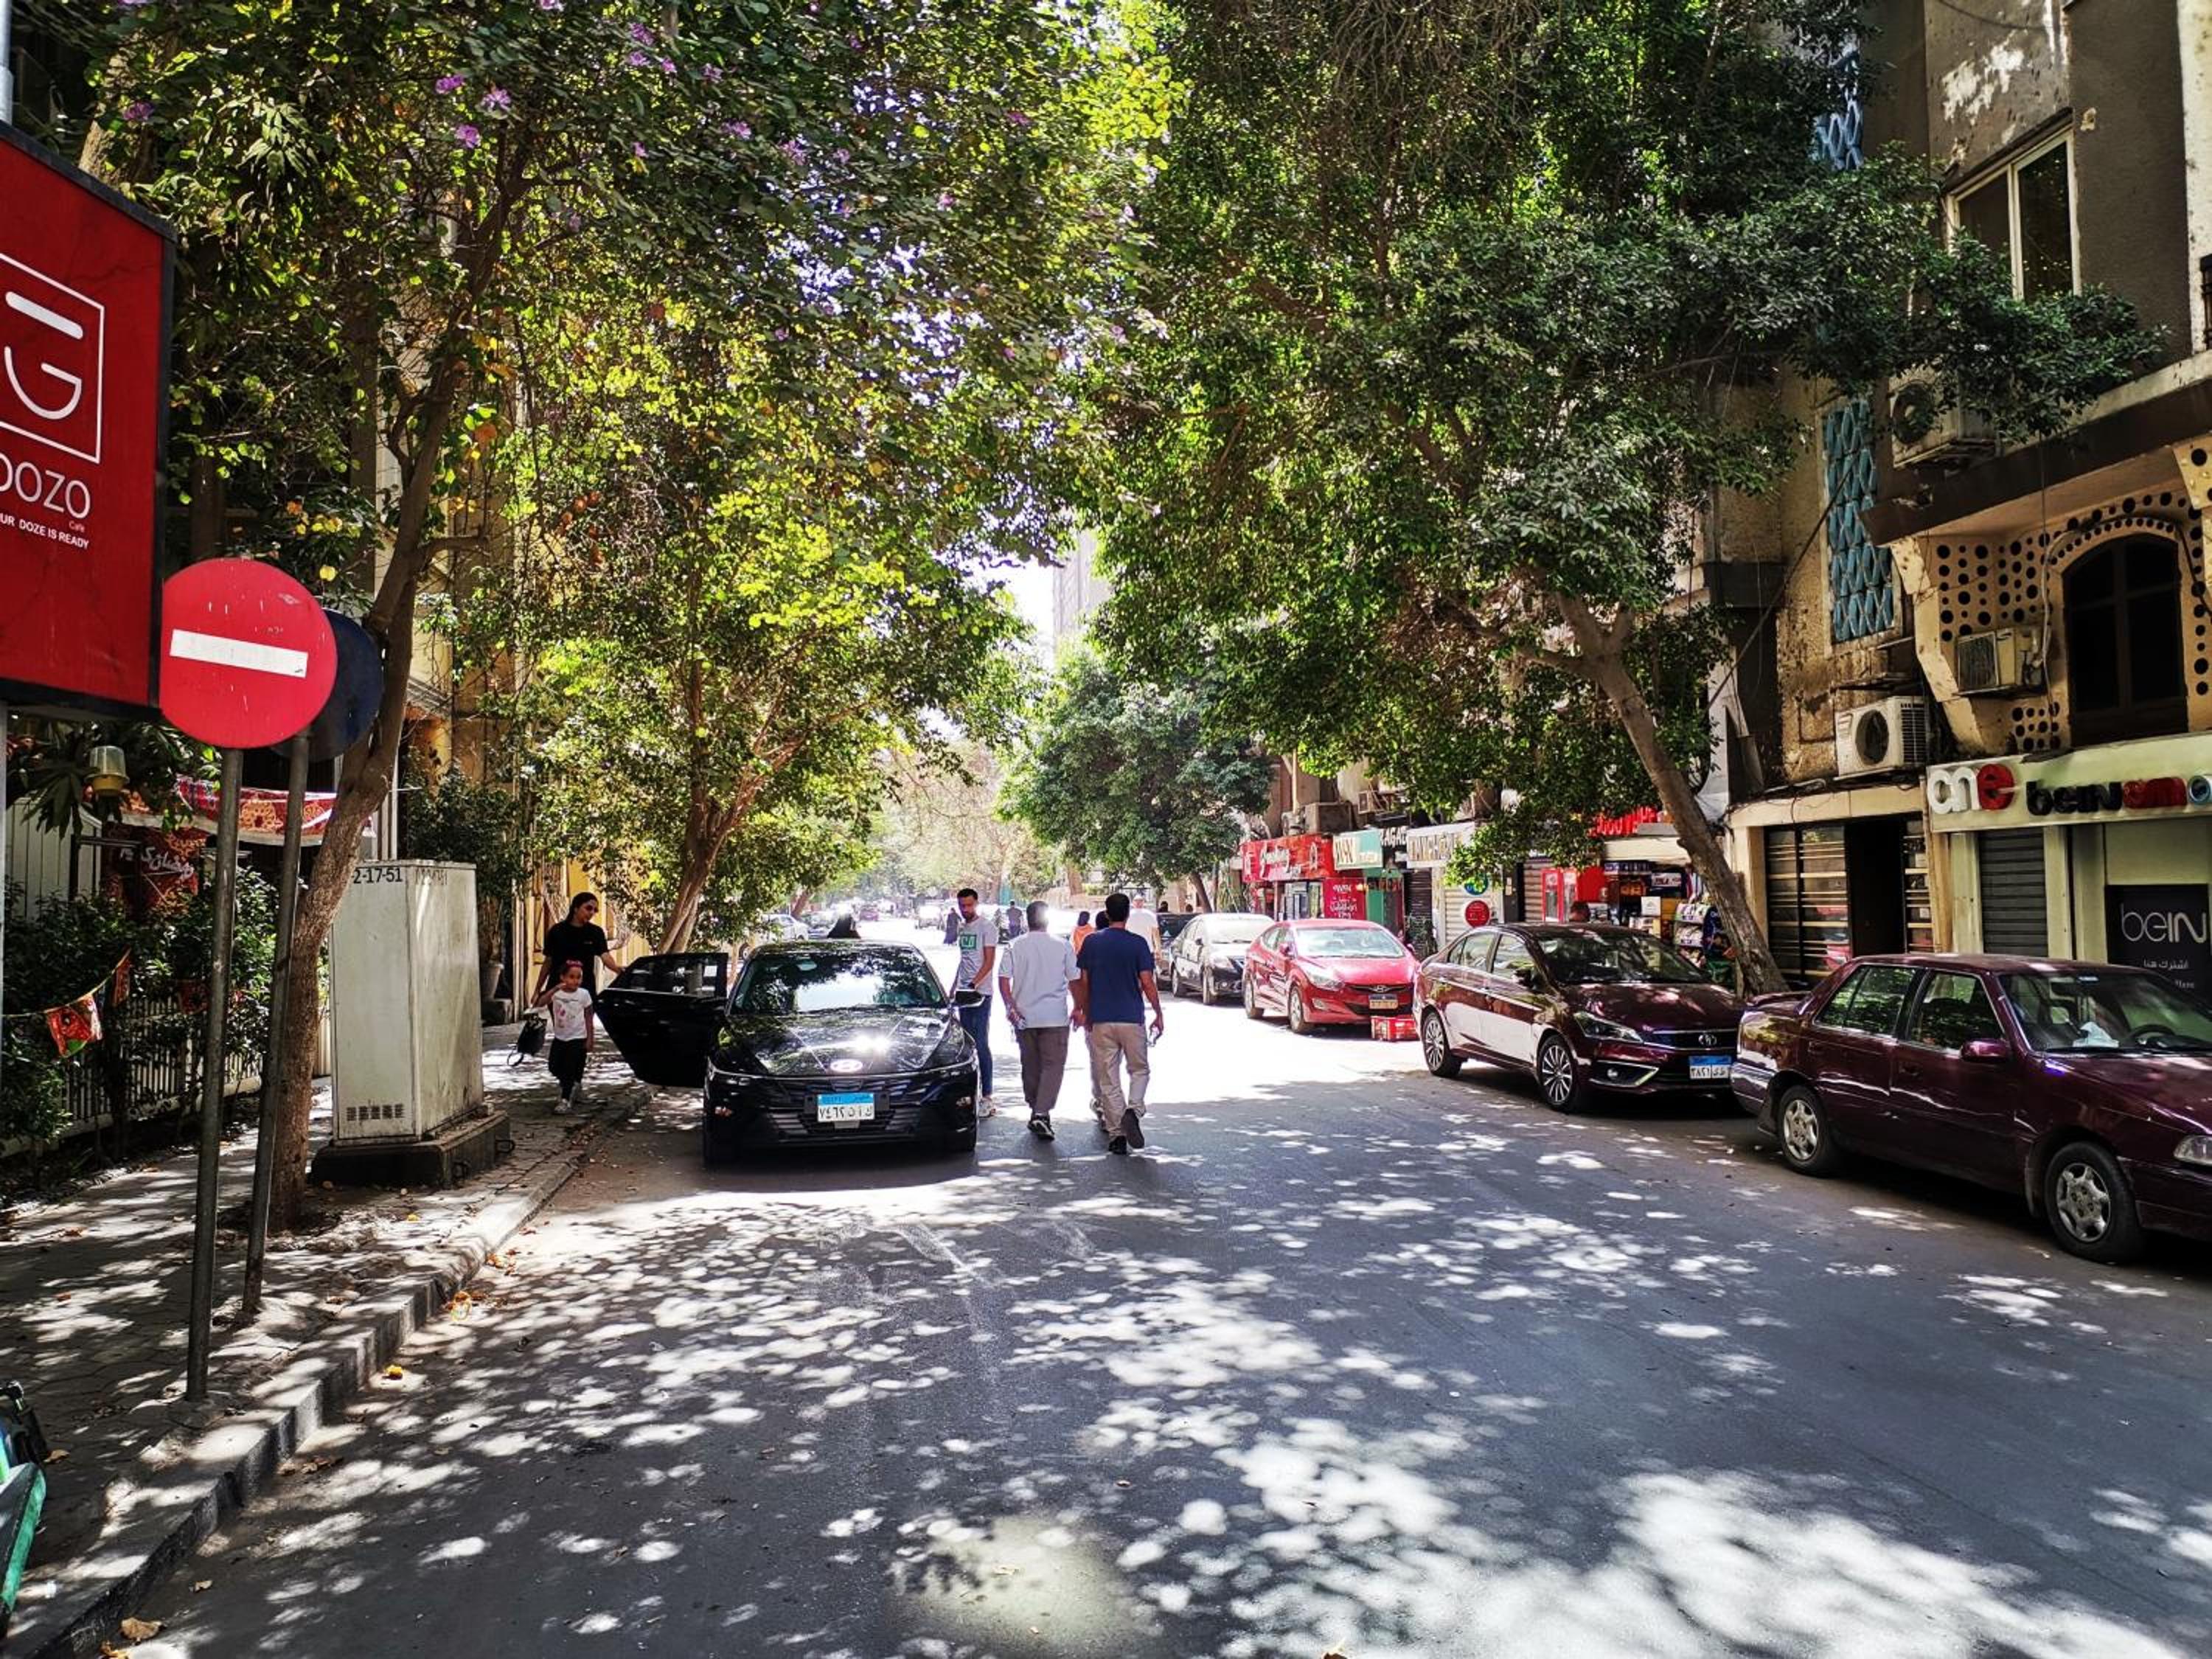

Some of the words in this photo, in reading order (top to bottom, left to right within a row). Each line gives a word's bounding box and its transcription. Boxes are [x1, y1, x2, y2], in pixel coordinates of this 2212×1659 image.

[18, 519, 46, 536] DOZE
[48, 528, 57, 540] IS
[58, 532, 89, 549] READY
